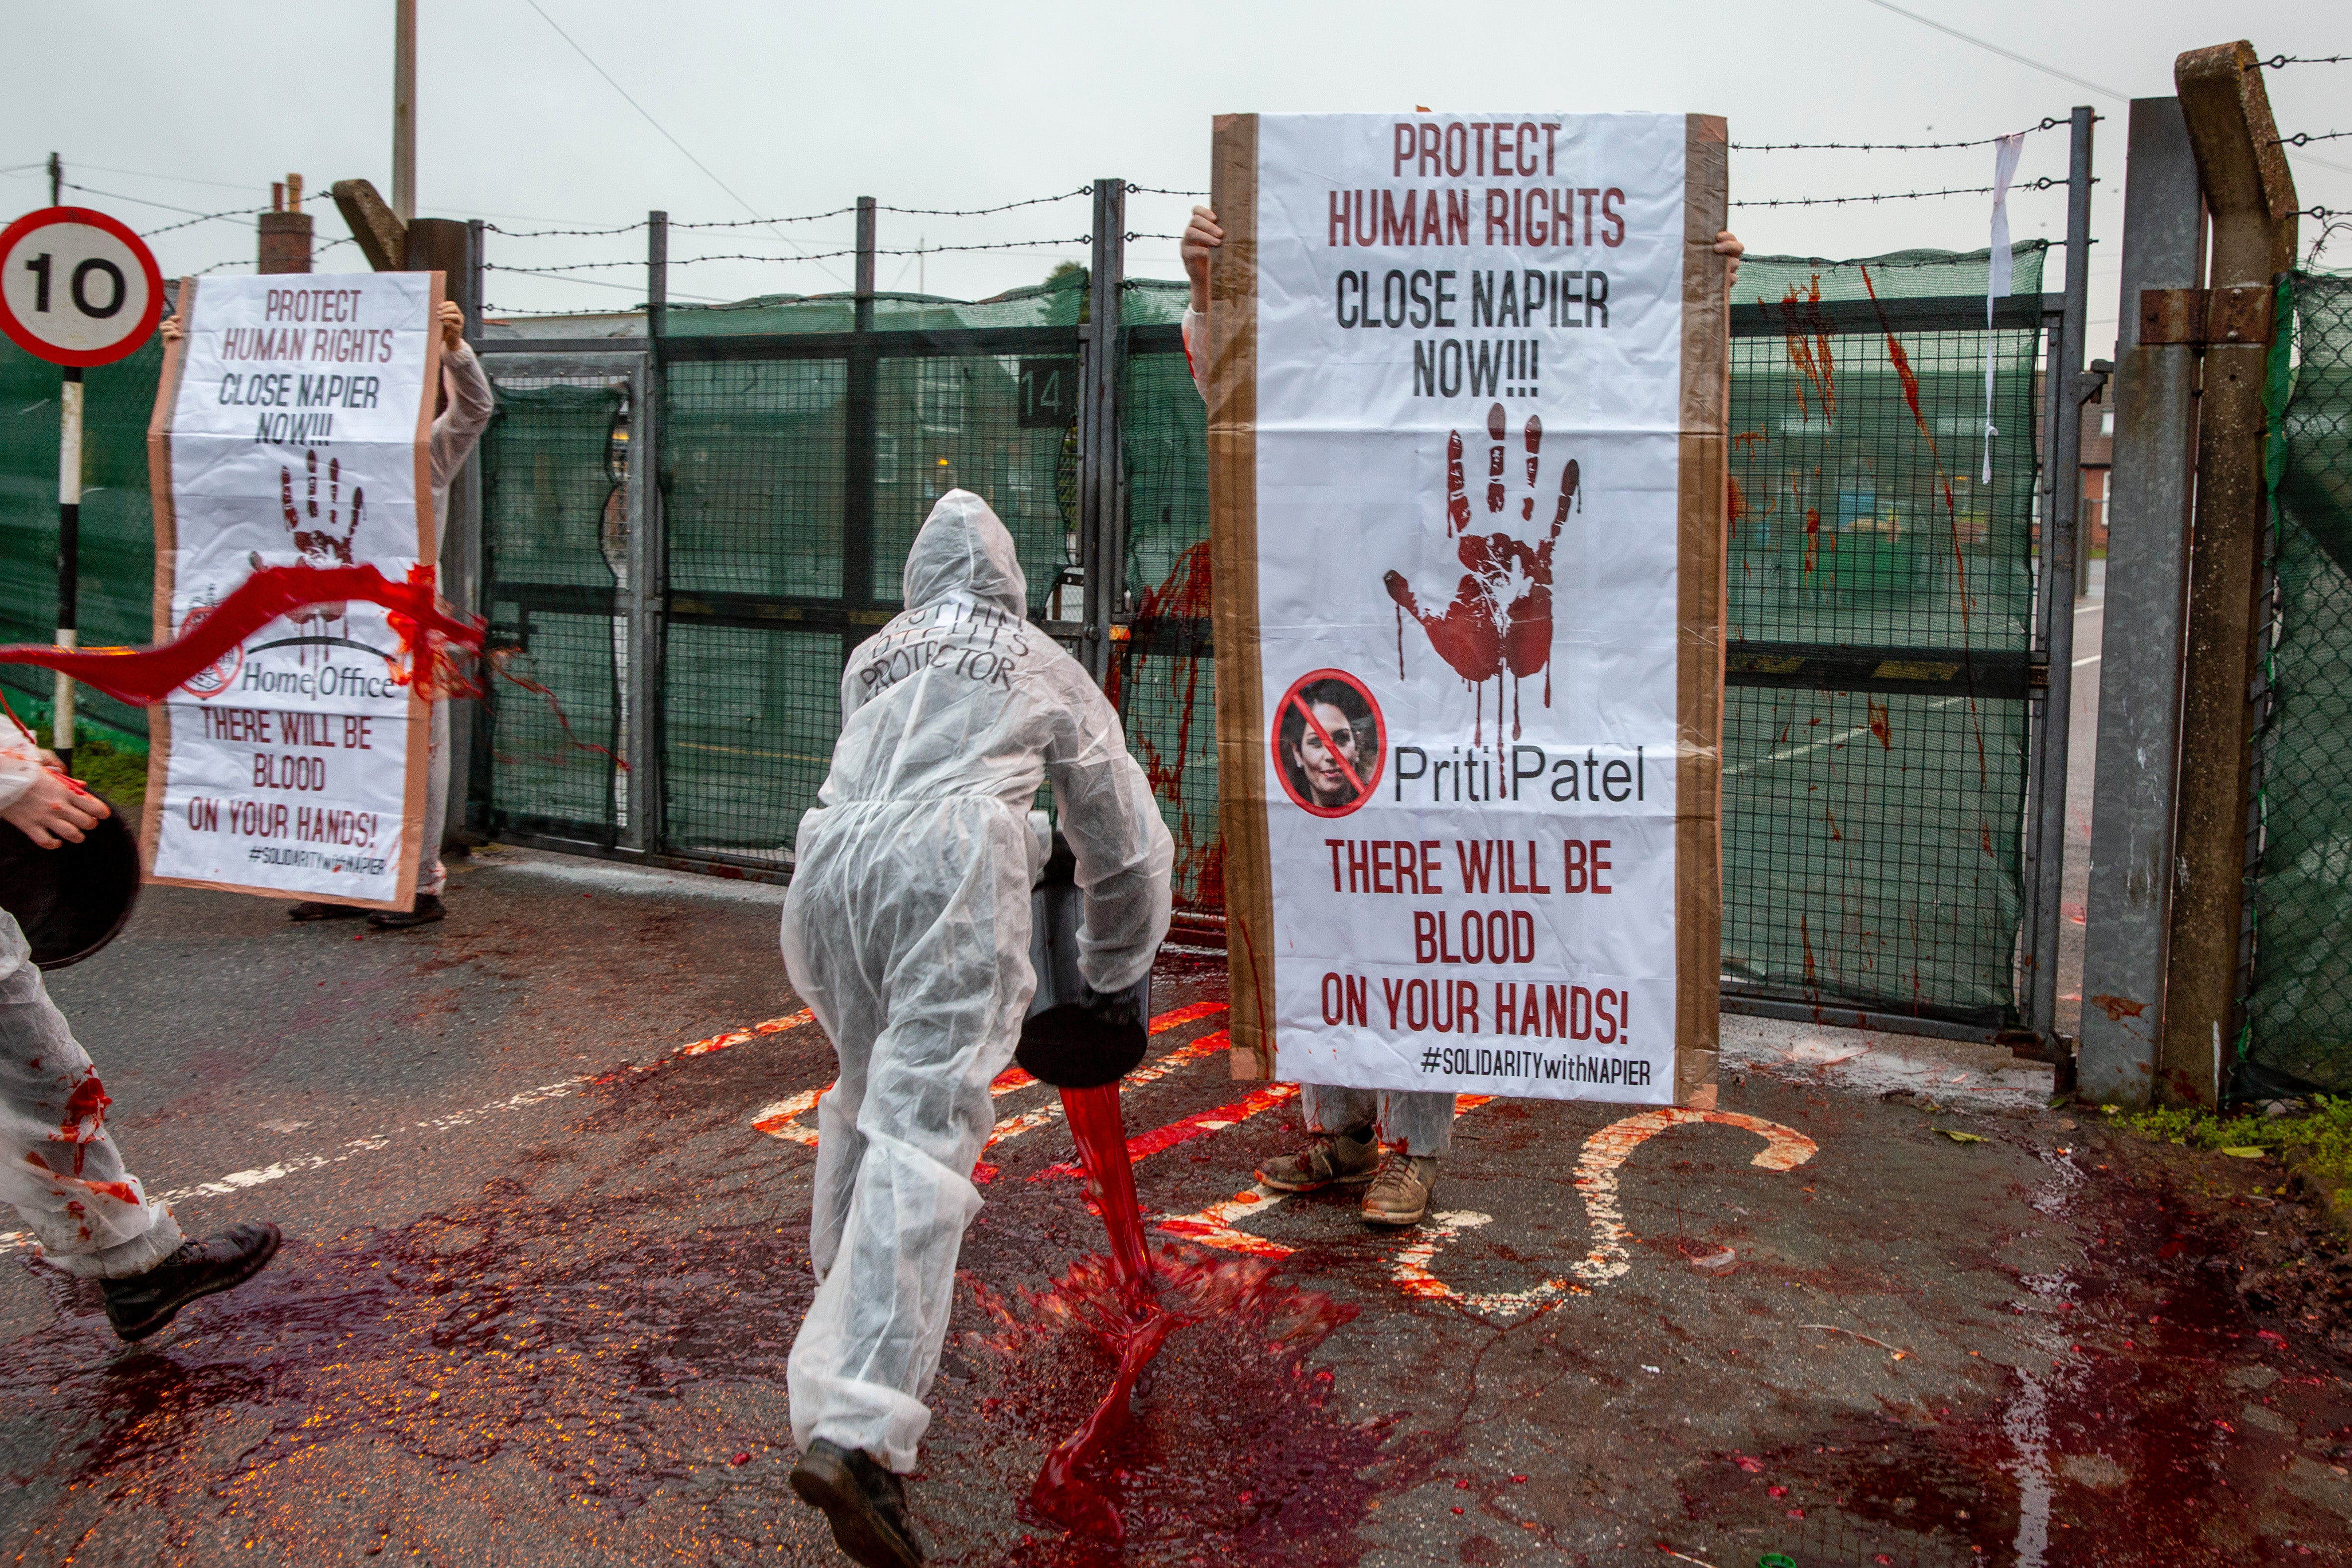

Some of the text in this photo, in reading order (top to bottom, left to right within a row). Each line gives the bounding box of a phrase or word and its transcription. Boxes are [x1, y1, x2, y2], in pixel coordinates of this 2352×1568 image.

[1393, 122, 1561, 177] PROTECT
[1328, 187, 1625, 247] HUMAN RIGHTS
[25, 253, 126, 319] 10
[265, 289, 362, 322] PROTECT
[1336, 269, 1610, 329] CLOSE NAPIER
[222, 328, 393, 363] HUMAN RIGHTS
[1413, 339, 1539, 398] NOW!!!
[218, 373, 380, 408] CLOSE NAPIER
[1021, 370, 1063, 416] 14
[254, 412, 333, 446] NOW!!!
[241, 662, 396, 698] Home Office
[201, 707, 372, 749] THERE WILL BE
[253, 753, 325, 791] BLOOD
[1395, 745, 1644, 803] Priti Patel
[188, 796, 378, 848] ON YOUR HANDS!
[248, 847, 385, 875] #SOLIDARITYwithNAPIER
[1325, 839, 1612, 894] THERE WILL BE
[1414, 910, 1534, 964] BLOOD
[1321, 971, 1628, 1045] ON YOUR HANDS!
[1420, 1047, 1651, 1086] #SOLIDARITYwithNAPIER
